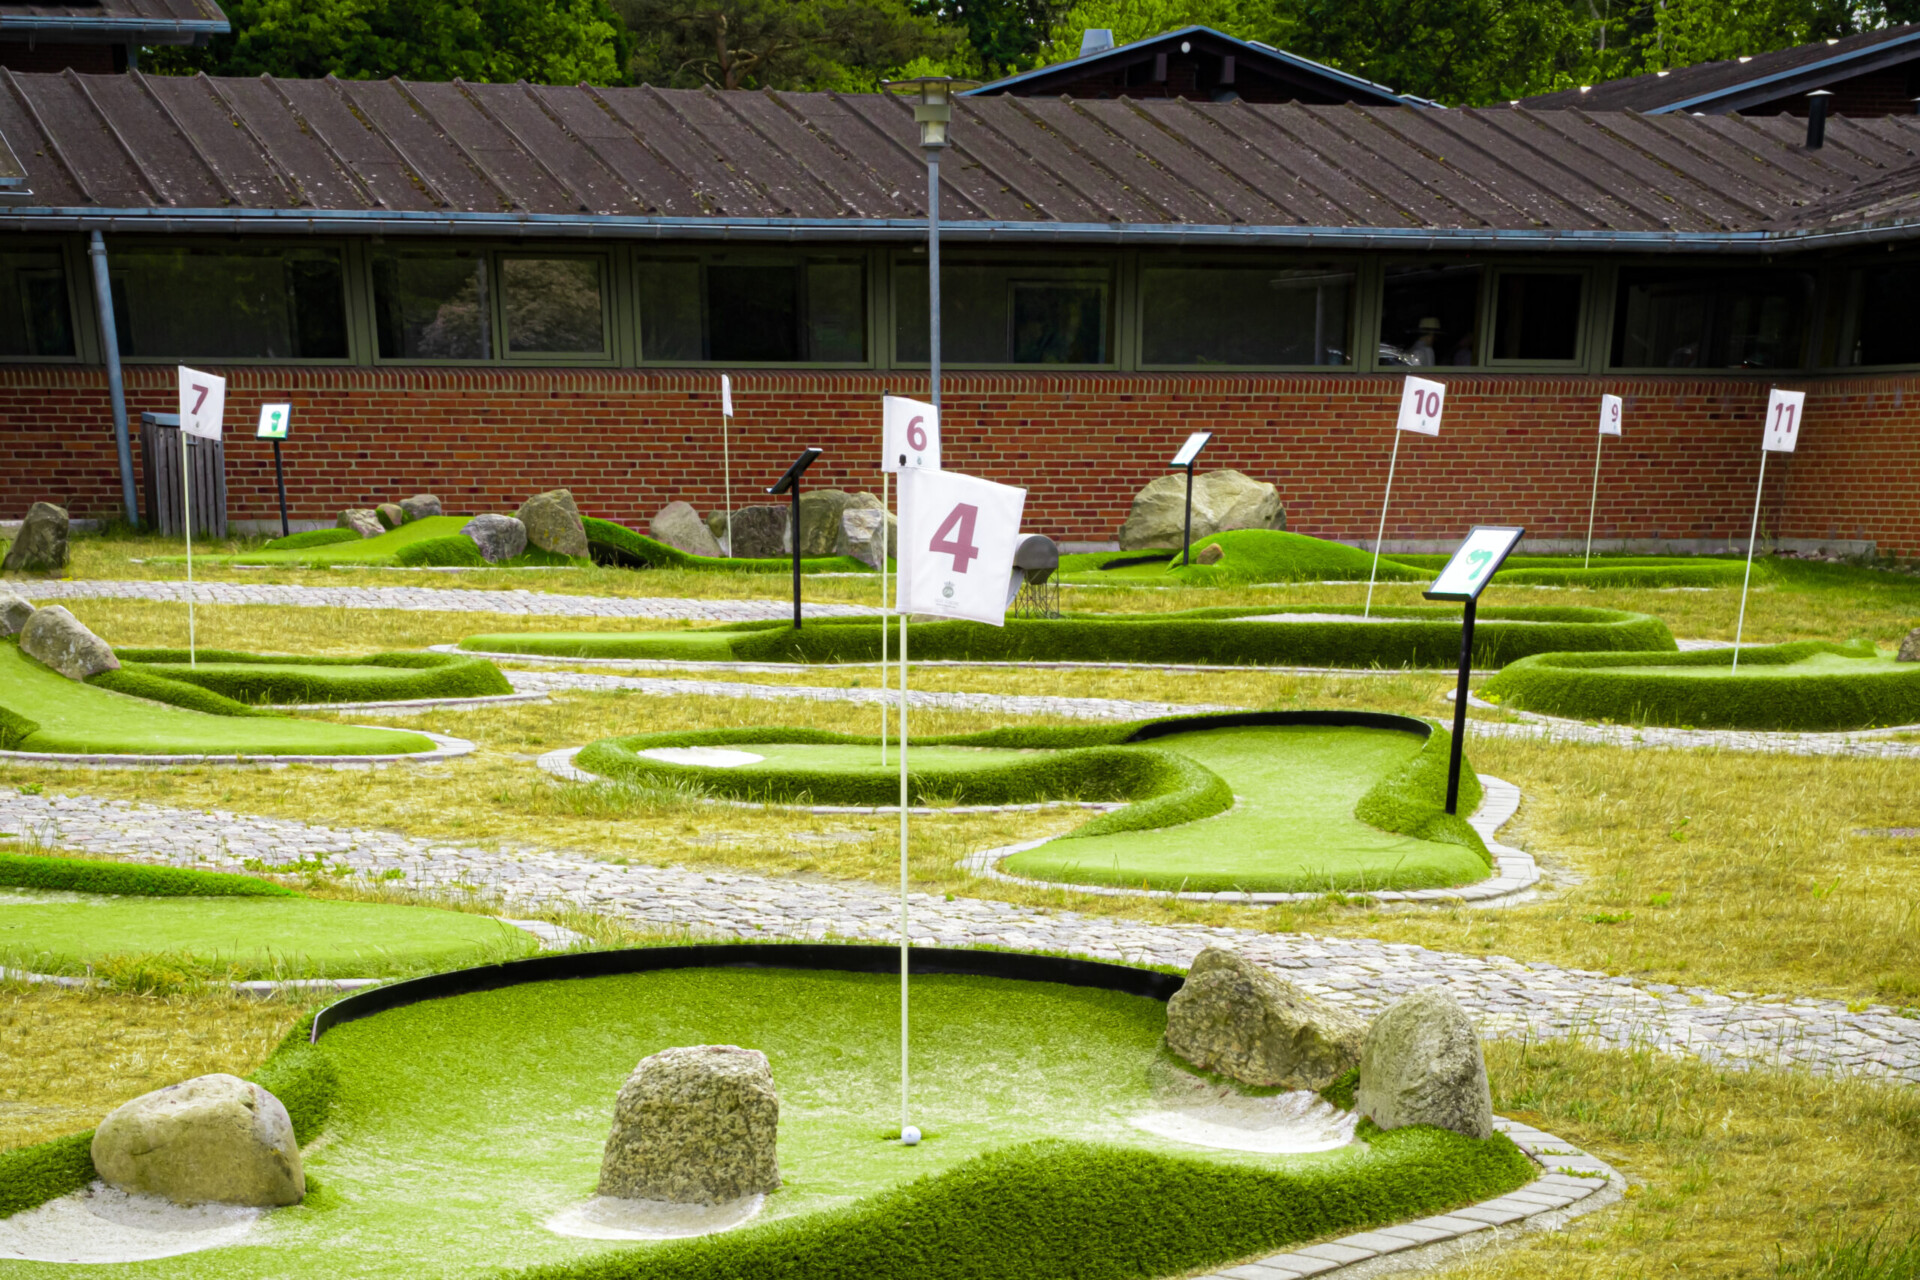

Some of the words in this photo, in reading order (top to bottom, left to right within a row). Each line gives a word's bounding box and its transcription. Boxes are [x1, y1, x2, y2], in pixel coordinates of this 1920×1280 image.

[191, 384, 209, 415] 7
[1414, 389, 1440, 418] 10
[1611, 403, 1619, 422] 9
[1774, 402, 1796, 433] 11
[907, 416, 927, 451] 6
[929, 503, 979, 574] 4
